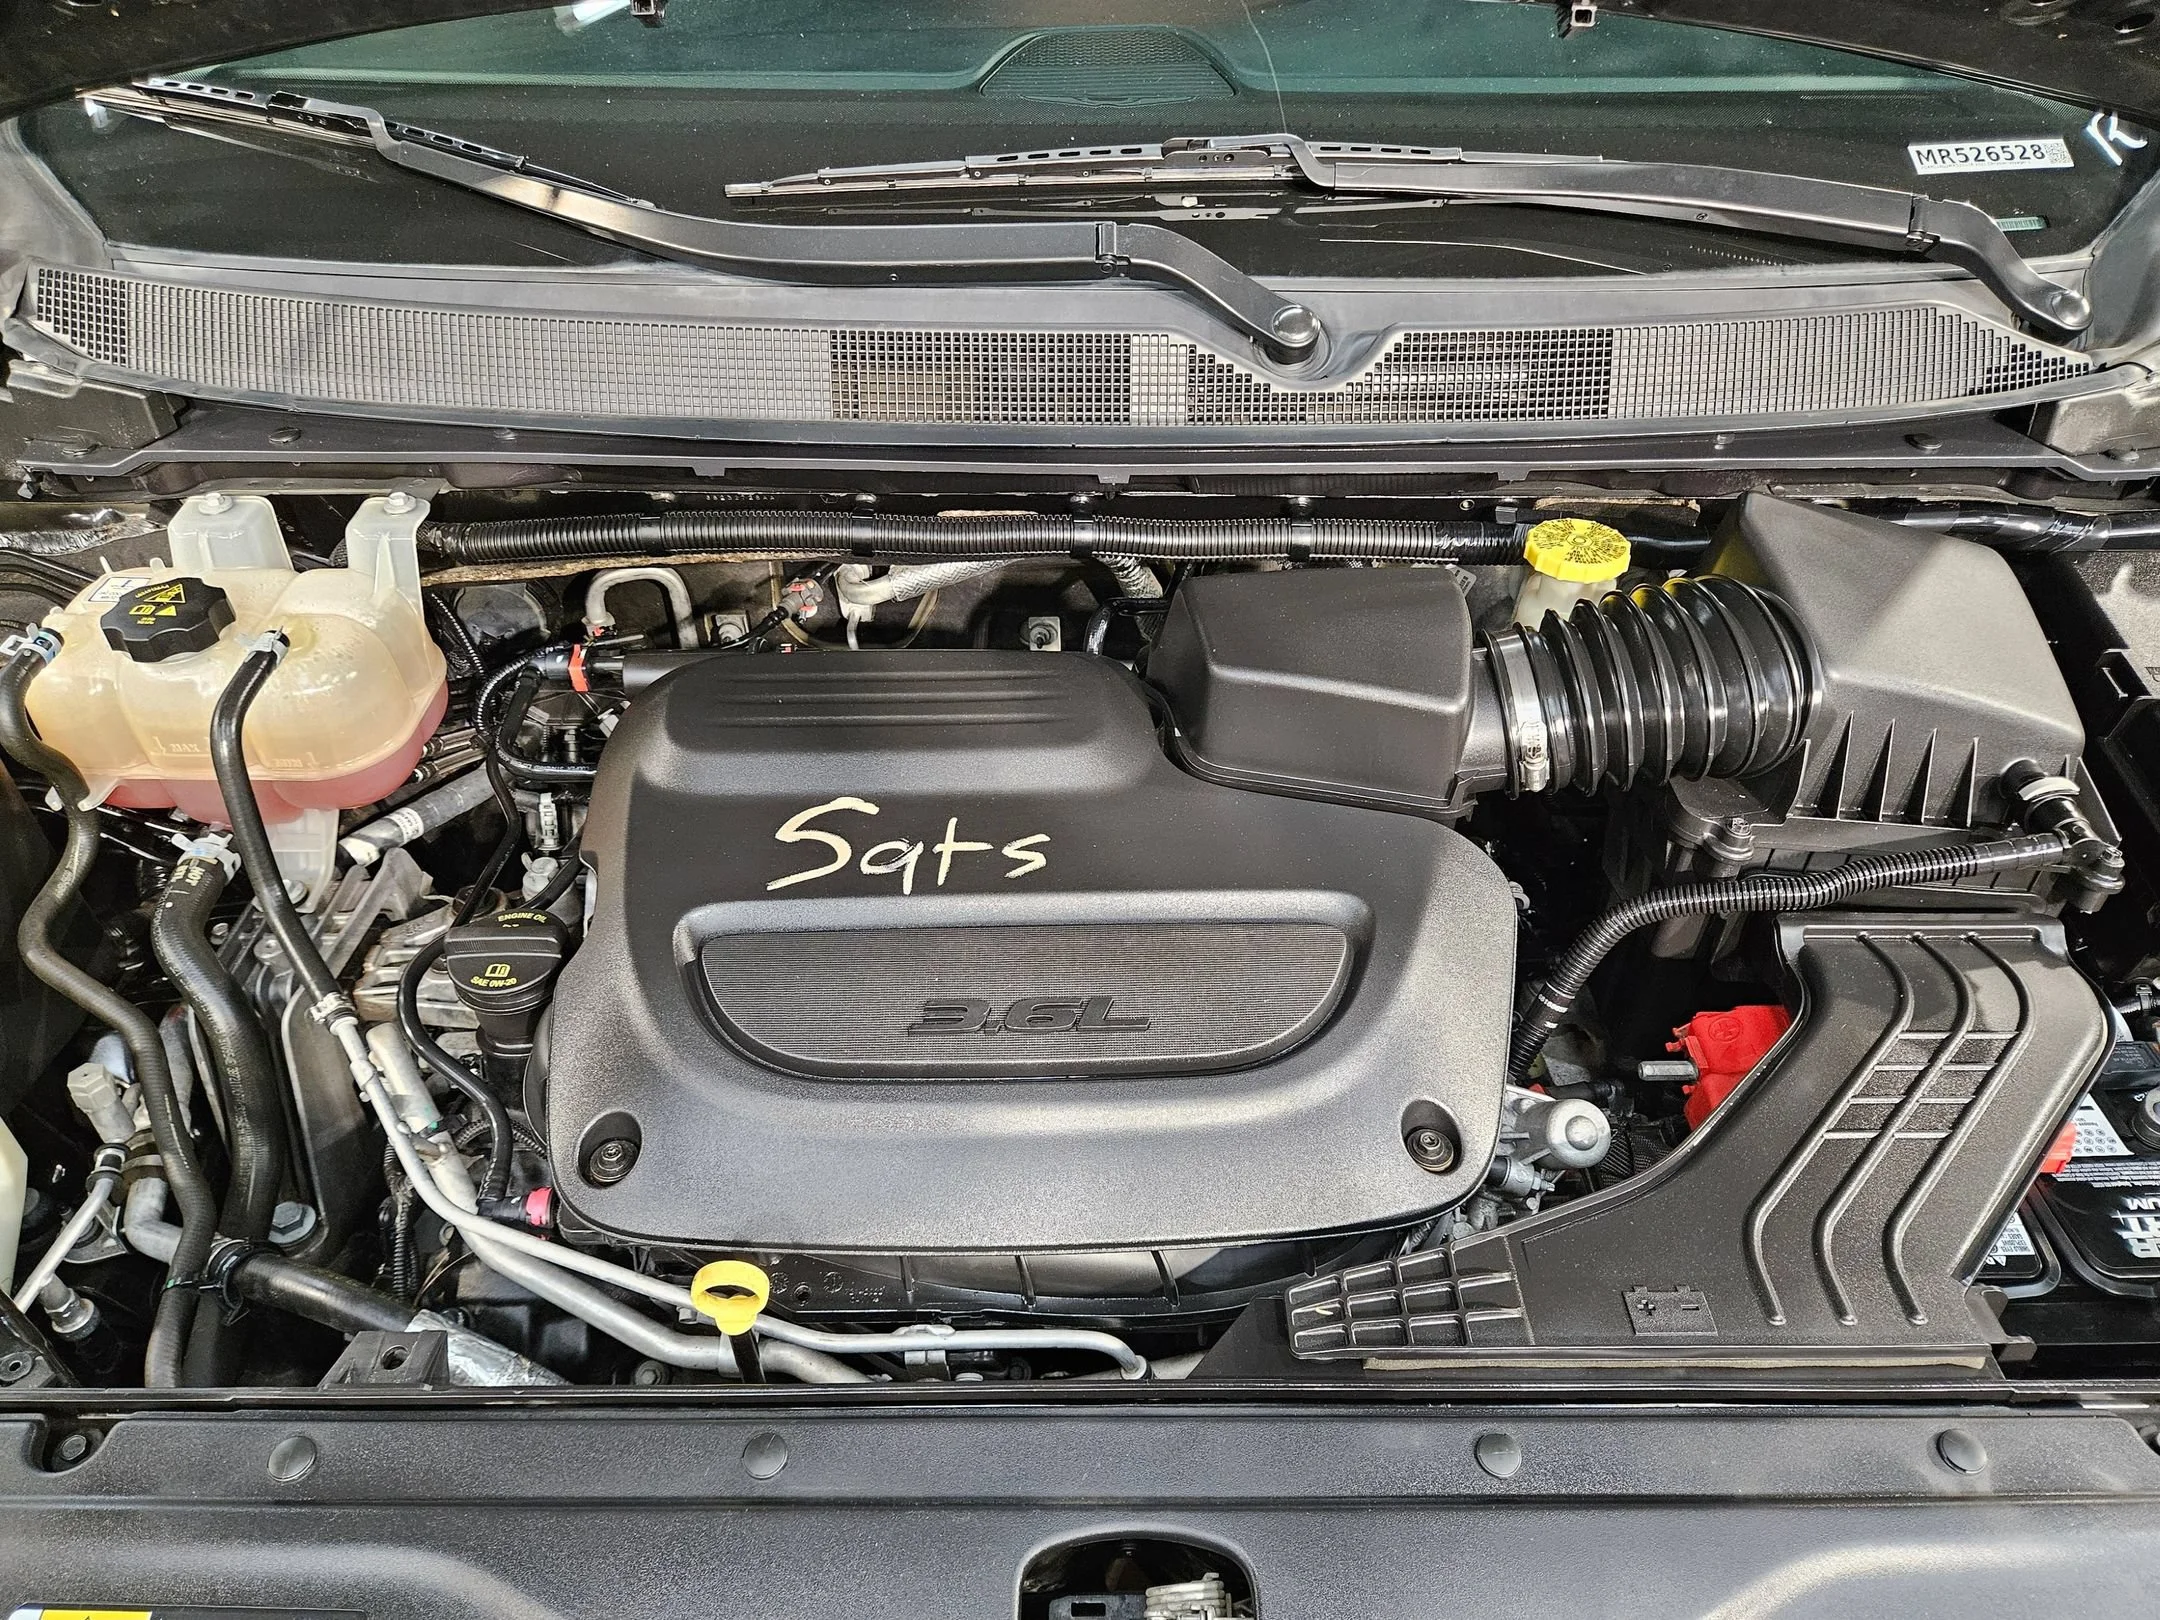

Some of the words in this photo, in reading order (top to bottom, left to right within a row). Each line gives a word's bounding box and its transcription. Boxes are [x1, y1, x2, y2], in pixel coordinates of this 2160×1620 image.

[1914, 143, 2047, 166] MR526528
[497, 911, 533, 923] ENGINE
[533, 913, 548, 924] OIL
[470, 976, 489, 987] SAE
[488, 977, 517, 988] 0W-20
[908, 996, 1150, 1036] 3.6L
